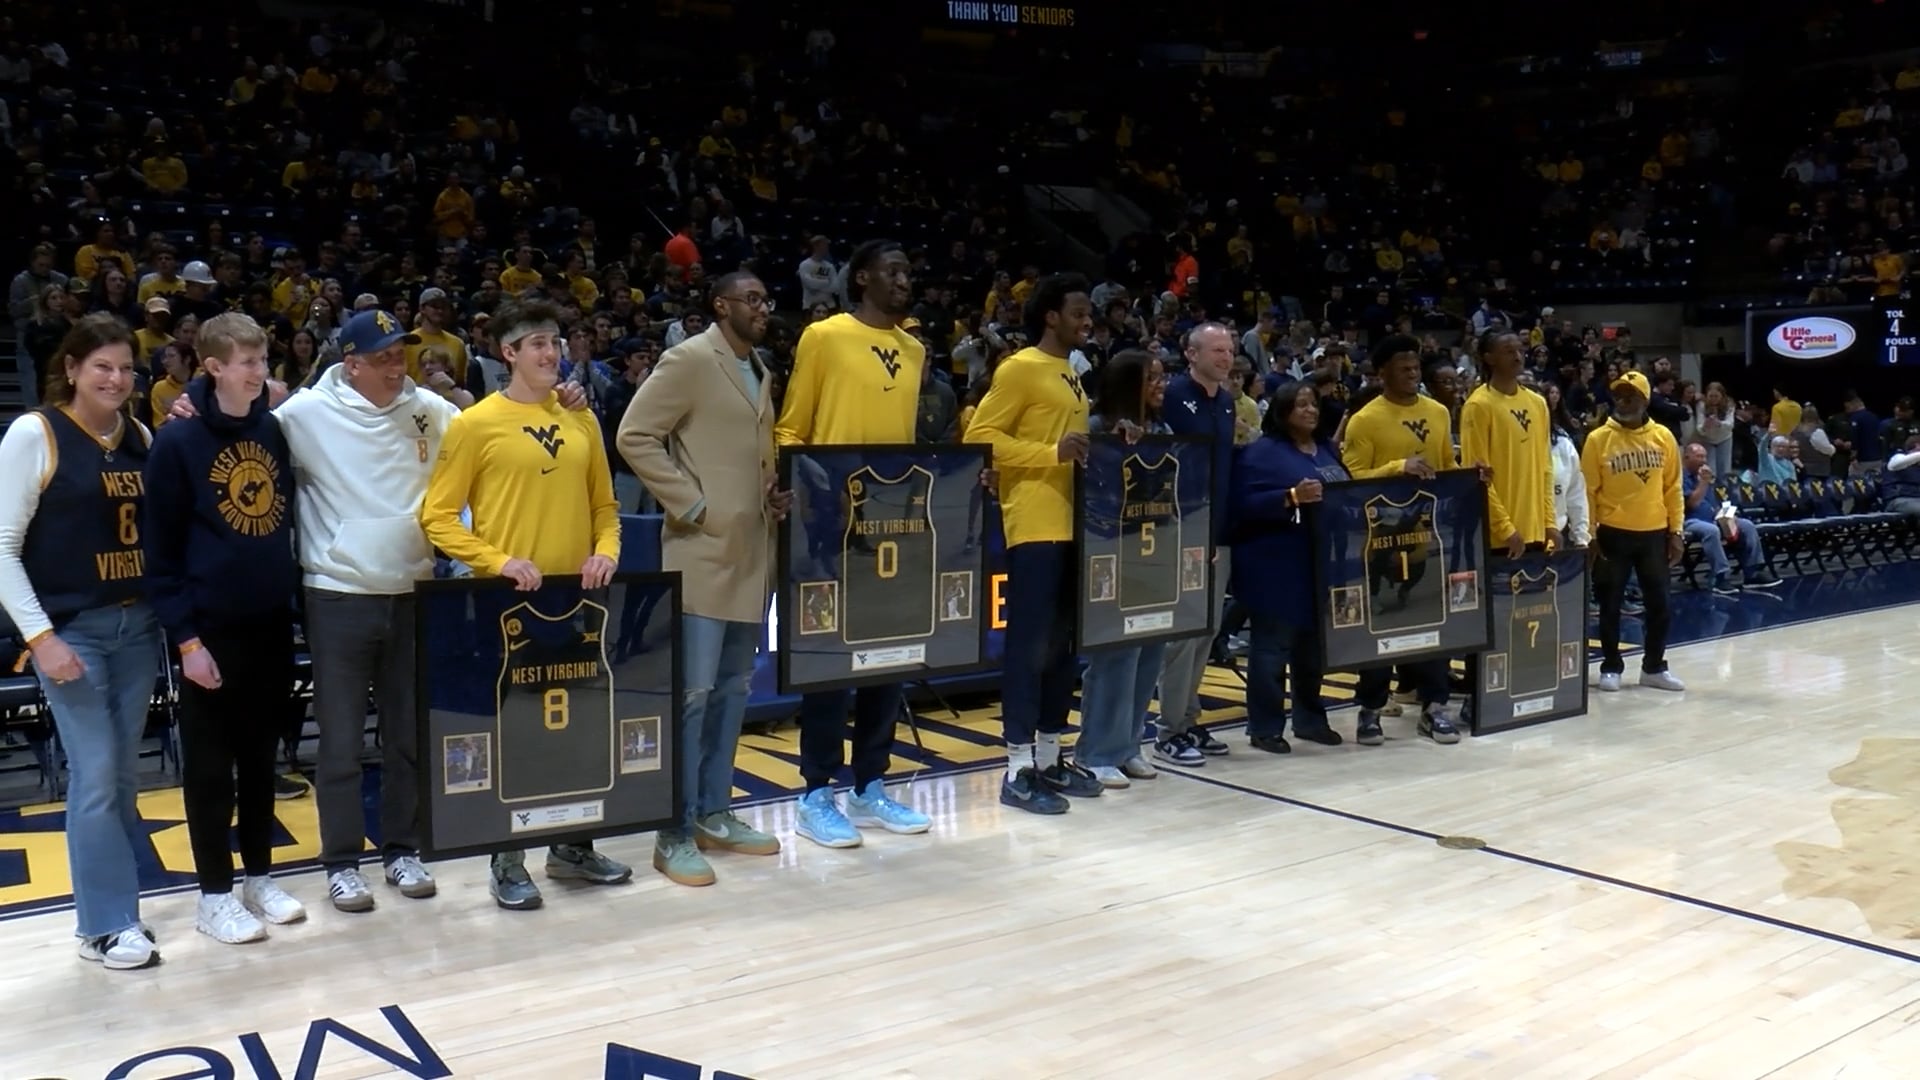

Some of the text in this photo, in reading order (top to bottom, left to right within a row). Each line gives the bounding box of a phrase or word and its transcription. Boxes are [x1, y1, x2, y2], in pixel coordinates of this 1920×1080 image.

[947, 1, 1074, 27] THANK YOU SENIORS
[1885, 310, 1905, 318] TOL
[1782, 327, 1811, 341] Little
[1890, 319, 1900, 336] 4
[1789, 333, 1837, 351] General
[1885, 337, 1917, 346] FOULS
[1889, 346, 1898, 363] 0
[209, 440, 280, 484] WEST VIRGINIA
[417, 439, 428, 463] 8
[101, 471, 145, 497] WEST
[119, 502, 139, 545] 8
[217, 493, 287, 537] MOUNTAINEERS
[856, 519, 925, 535] WEST VIRGINIA
[1140, 521, 1156, 556] 5
[1372, 536, 1393, 550] WEST
[877, 541, 899, 578] 0
[1400, 551, 1409, 581] 1
[1528, 620, 1540, 648] 7
[512, 661, 598, 684] WEST VIRGINIA
[544, 688, 569, 730] 8
